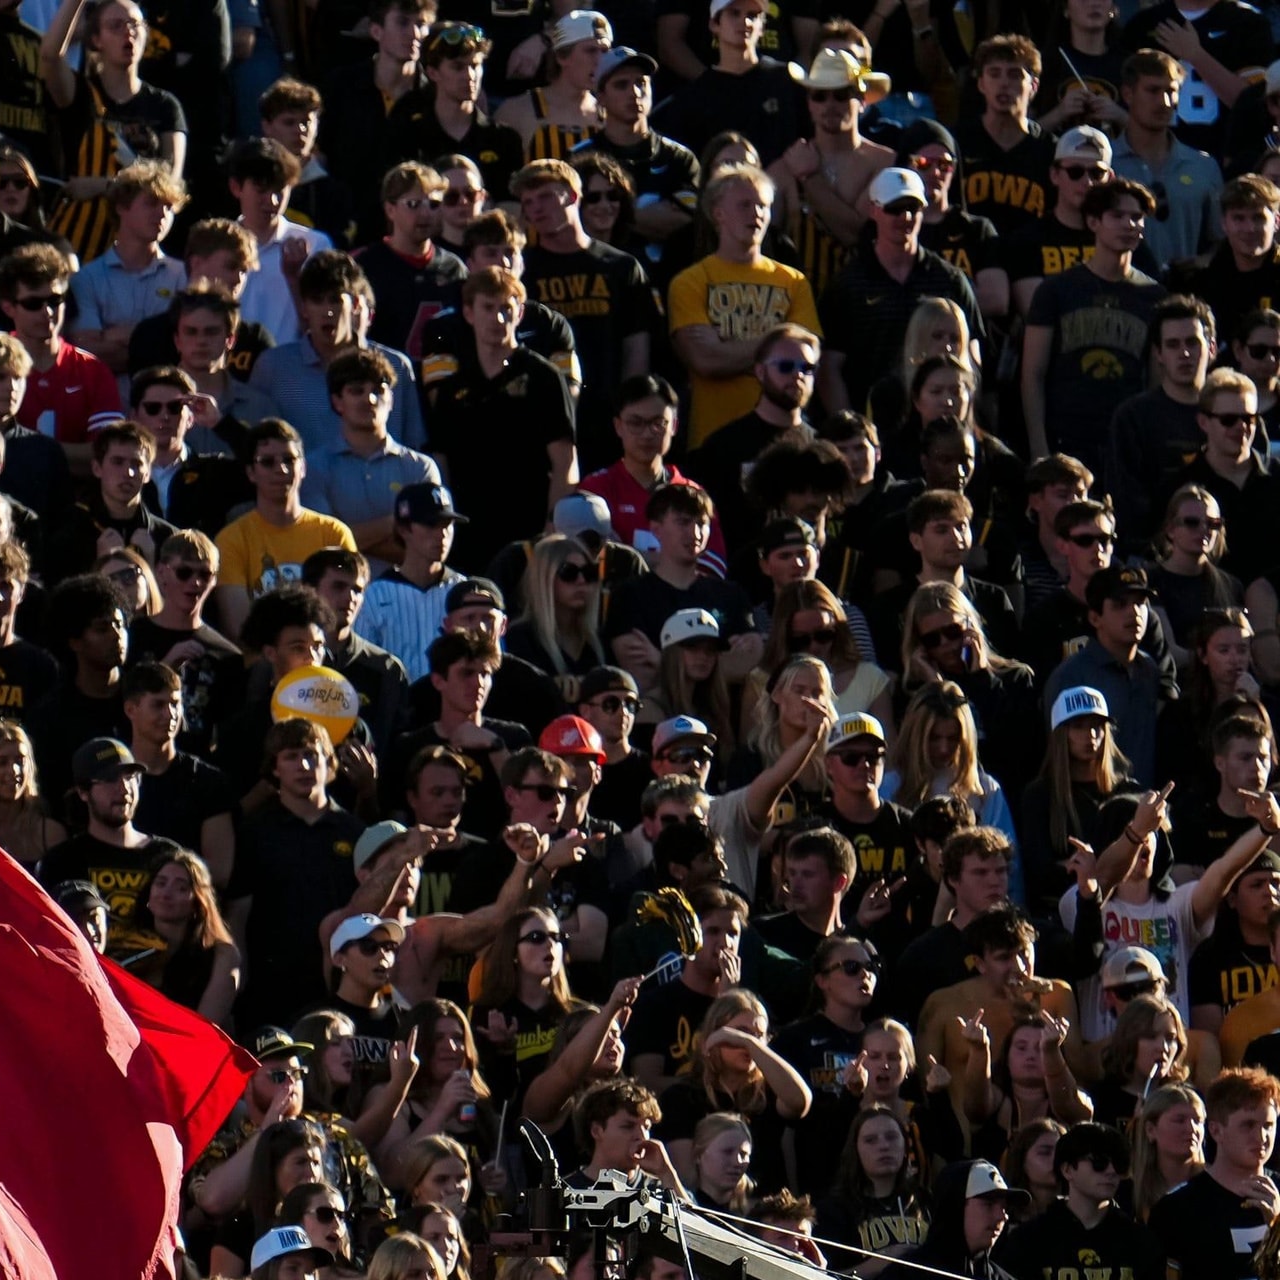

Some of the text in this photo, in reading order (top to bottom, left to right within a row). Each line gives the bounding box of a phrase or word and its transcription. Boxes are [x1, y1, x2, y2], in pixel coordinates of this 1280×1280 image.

[965, 171, 1046, 219] OWA
[536, 273, 611, 302] IOWA
[859, 847, 907, 872] WA
[1221, 962, 1280, 1006] IOW
[859, 1214, 931, 1252] IOWA
